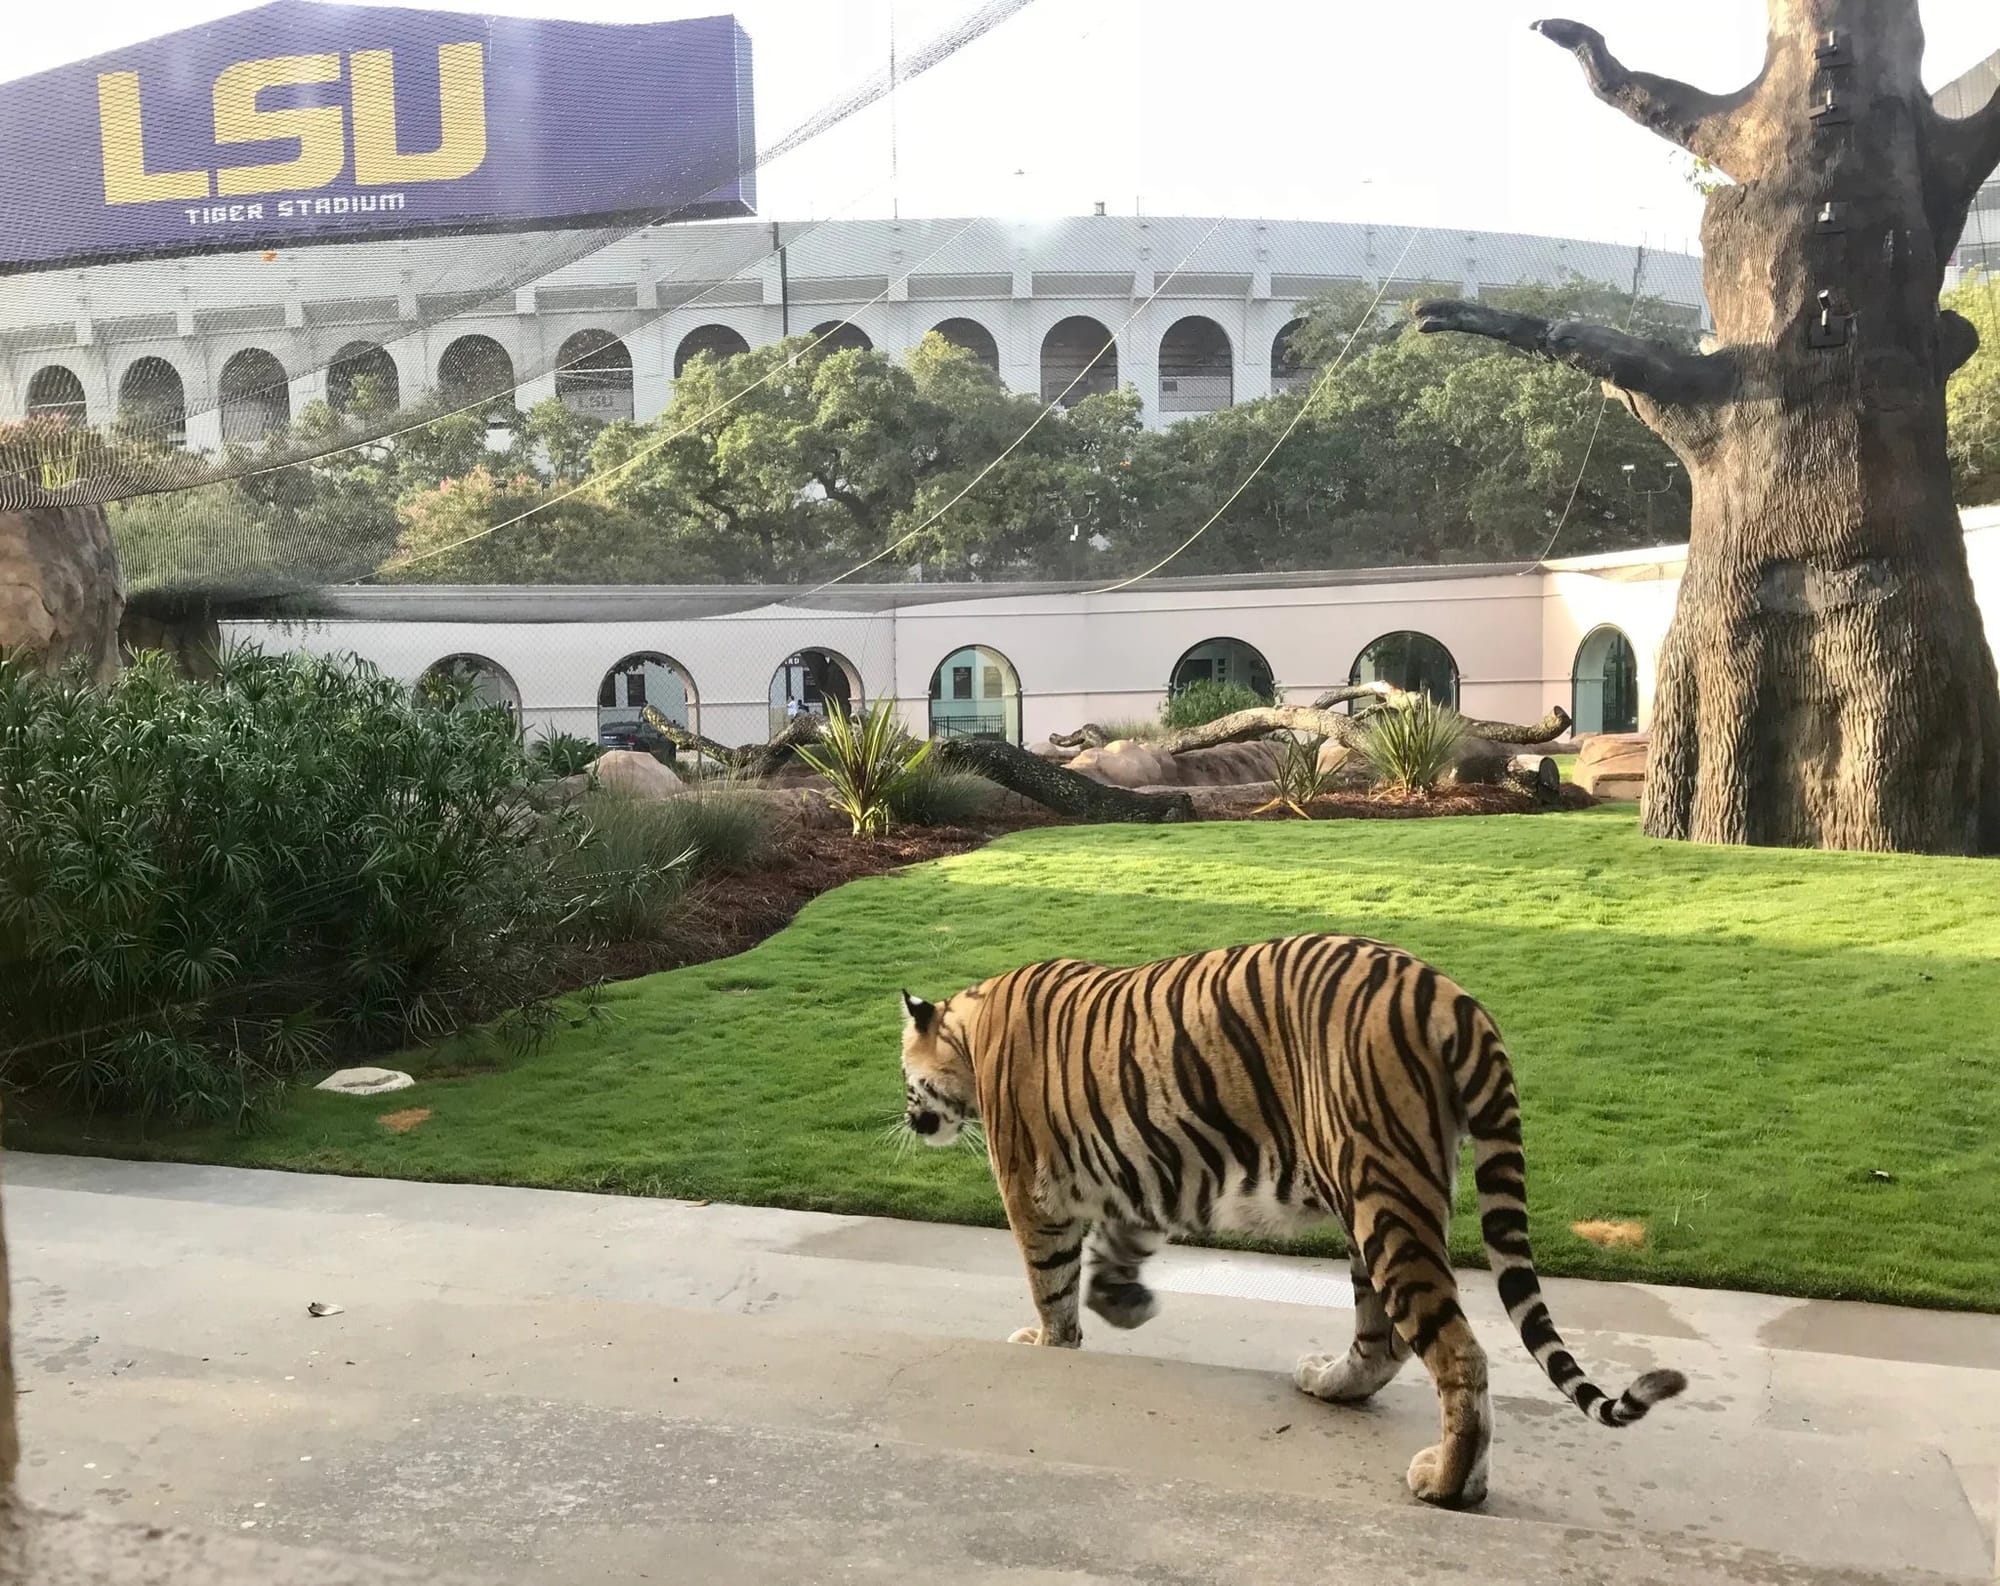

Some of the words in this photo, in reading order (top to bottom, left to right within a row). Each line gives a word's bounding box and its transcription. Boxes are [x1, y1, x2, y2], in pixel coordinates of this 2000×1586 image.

[98, 41, 486, 205] LSU
[185, 203, 263, 225] TIGER
[278, 192, 405, 217] STADIUM
